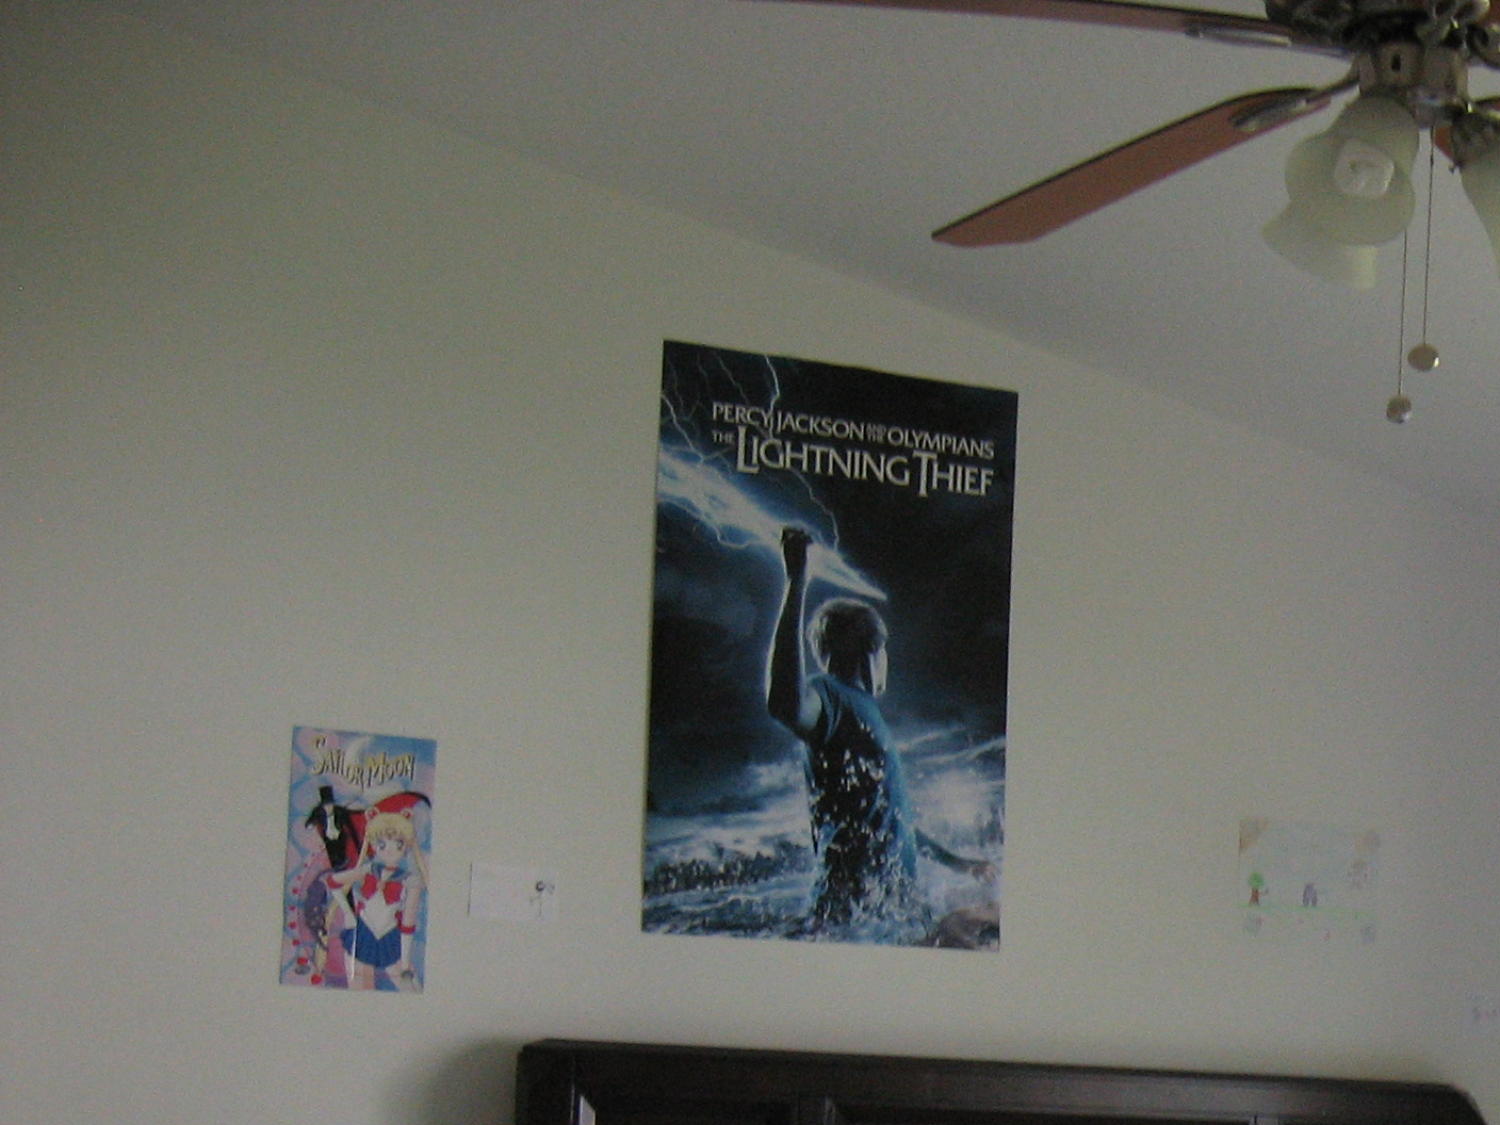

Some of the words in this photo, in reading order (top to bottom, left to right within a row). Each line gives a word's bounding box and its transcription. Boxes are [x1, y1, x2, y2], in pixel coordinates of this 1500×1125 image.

[712, 402, 770, 428] PERCY
[777, 411, 865, 442] JACKSON
[711, 430, 735, 445] THE
[736, 426, 910, 487] LIGHTNING
[913, 450, 995, 498] THIEF
[887, 427, 995, 460] OLYMPIANS
